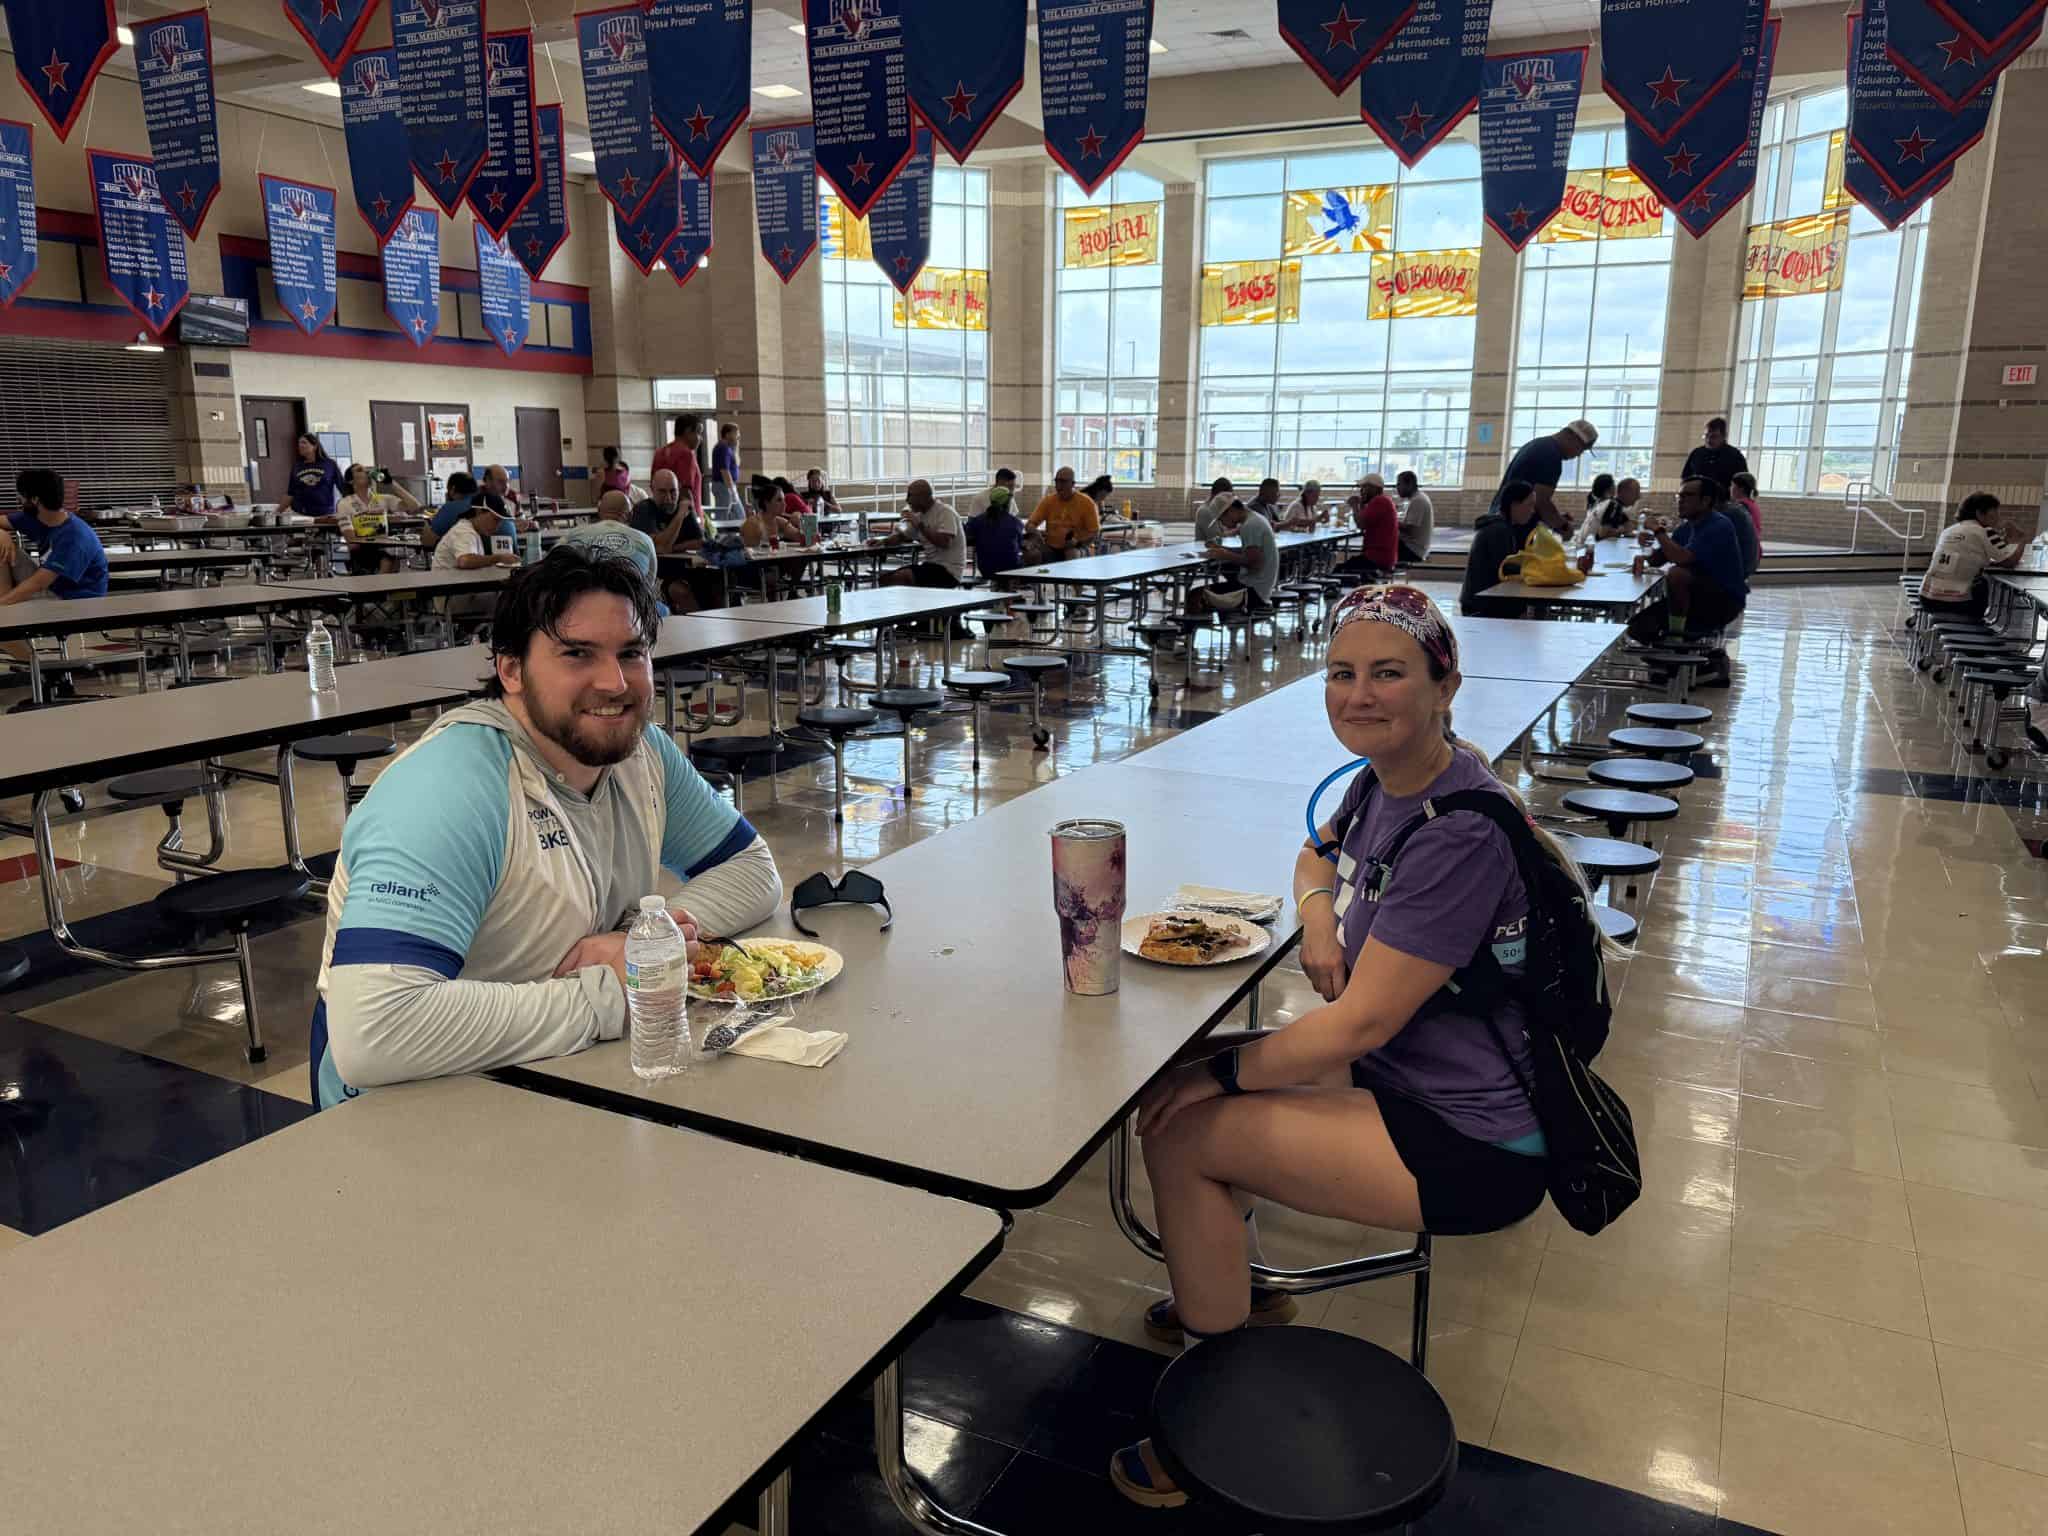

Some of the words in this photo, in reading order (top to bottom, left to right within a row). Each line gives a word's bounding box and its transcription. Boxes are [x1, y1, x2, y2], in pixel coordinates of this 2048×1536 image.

[1603, 2, 1641, 13] Jessica
[150, 25, 188, 57] ROYAL
[599, 16, 642, 45] ROYAL
[1502, 59, 1555, 87] ROYAL
[1857, 76, 1900, 85] Eduardo
[1855, 89, 1894, 98] Damian
[113, 164, 159, 189] ROYAL
[280, 187, 318, 211] ROYAL
[1559, 184, 1664, 229] IGHTING
[1078, 213, 1150, 256] ROYAL
[1744, 240, 1847, 283] FALCONS
[1375, 263, 1474, 303] SCHOOL
[2008, 366, 2033, 383] EXIT
[370, 880, 428, 902] reliant
